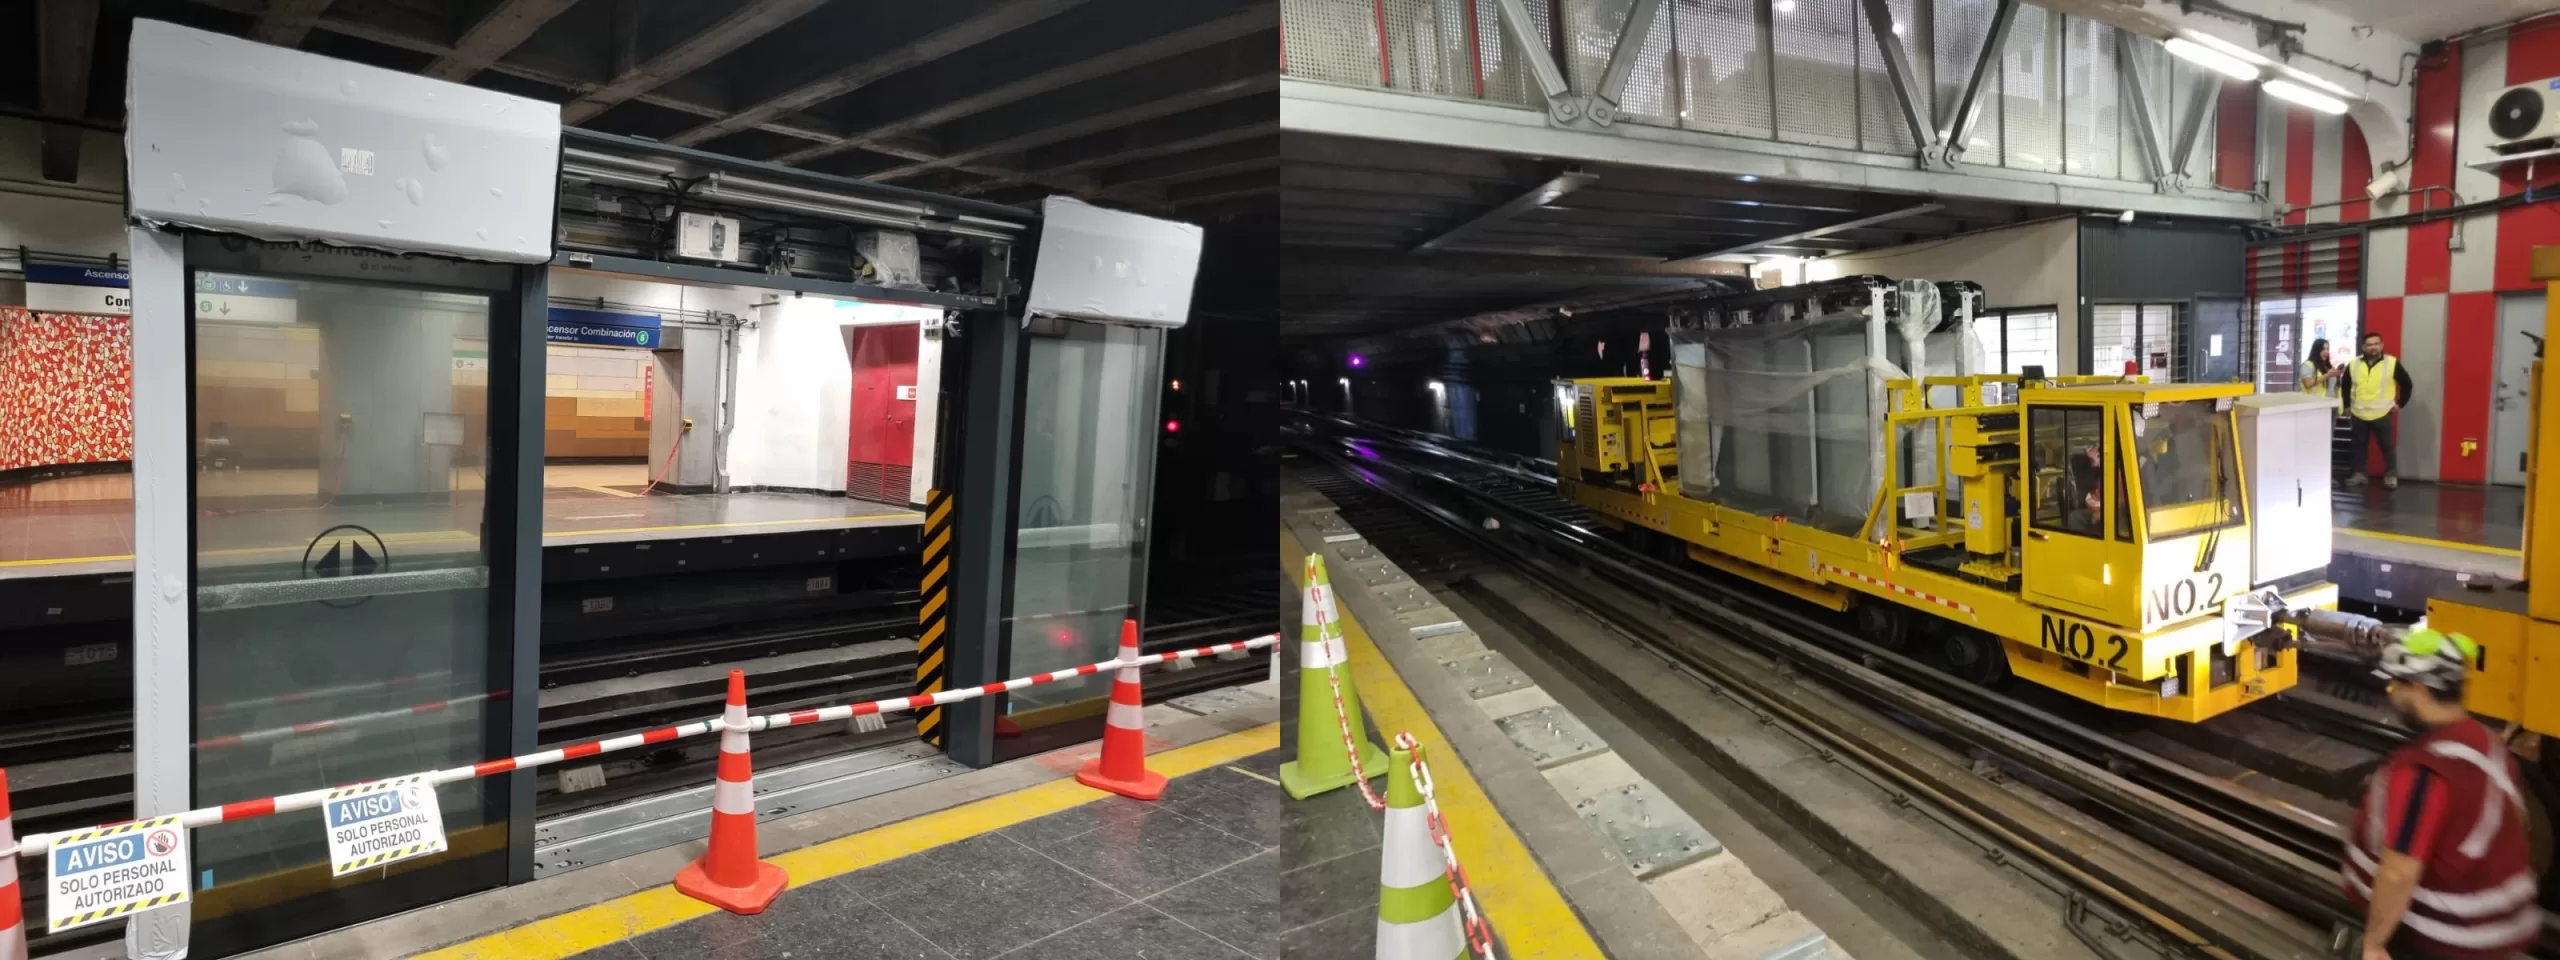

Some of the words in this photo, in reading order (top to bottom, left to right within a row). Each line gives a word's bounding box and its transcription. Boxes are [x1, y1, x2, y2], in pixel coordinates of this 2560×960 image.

[581, 326, 636, 339] Combinación
[2146, 573, 2223, 624] NO.2
[2041, 613, 2129, 672] NO.2
[340, 794, 392, 823] AVISO
[336, 825, 368, 844] SOLO
[370, 813, 429, 836] PERSONAL
[350, 828, 421, 857] AUTORIZADO
[67, 839, 134, 872] AVISO
[60, 875, 99, 895] SOLO
[103, 859, 177, 886] PERSONAL
[74, 878, 164, 910] AUTORIZADO
